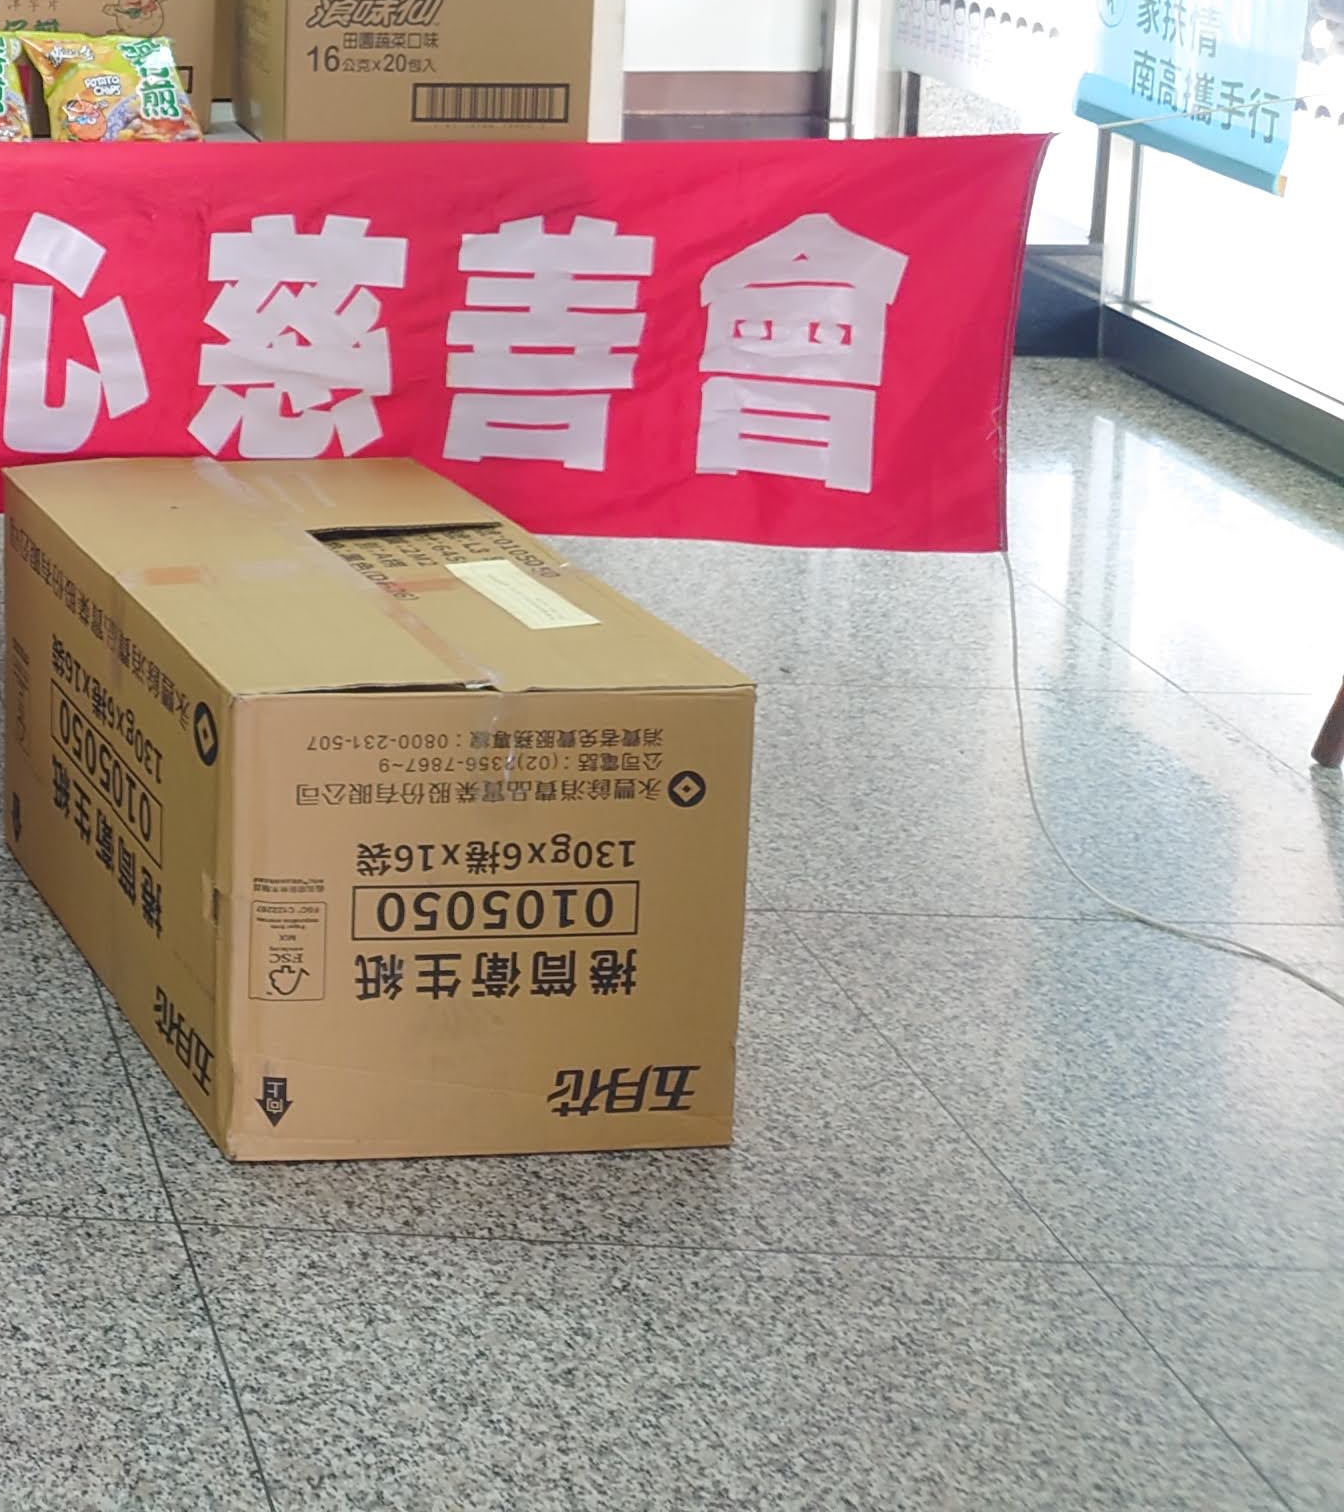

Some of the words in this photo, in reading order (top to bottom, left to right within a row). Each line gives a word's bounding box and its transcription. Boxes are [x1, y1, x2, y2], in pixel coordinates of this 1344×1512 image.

[343, 32, 439, 50] 田園蔬菜口味
[84, 75, 121, 89] POTATO
[1131, 49, 1280, 144] 南高攜手行
[58, 698, 152, 837] 0105050
[295, 778, 662, 808] 永豐餘消費品實業股份有限公司
[50, 756, 163, 941] 捲筒衛生紙
[375, 887, 616, 933] 0105050
[268, 952, 304, 964] FSC
[353, 948, 639, 1001] 捲筒衛生紙
[152, 985, 215, 1098] 五月花
[546, 1064, 703, 1118] 五月花
